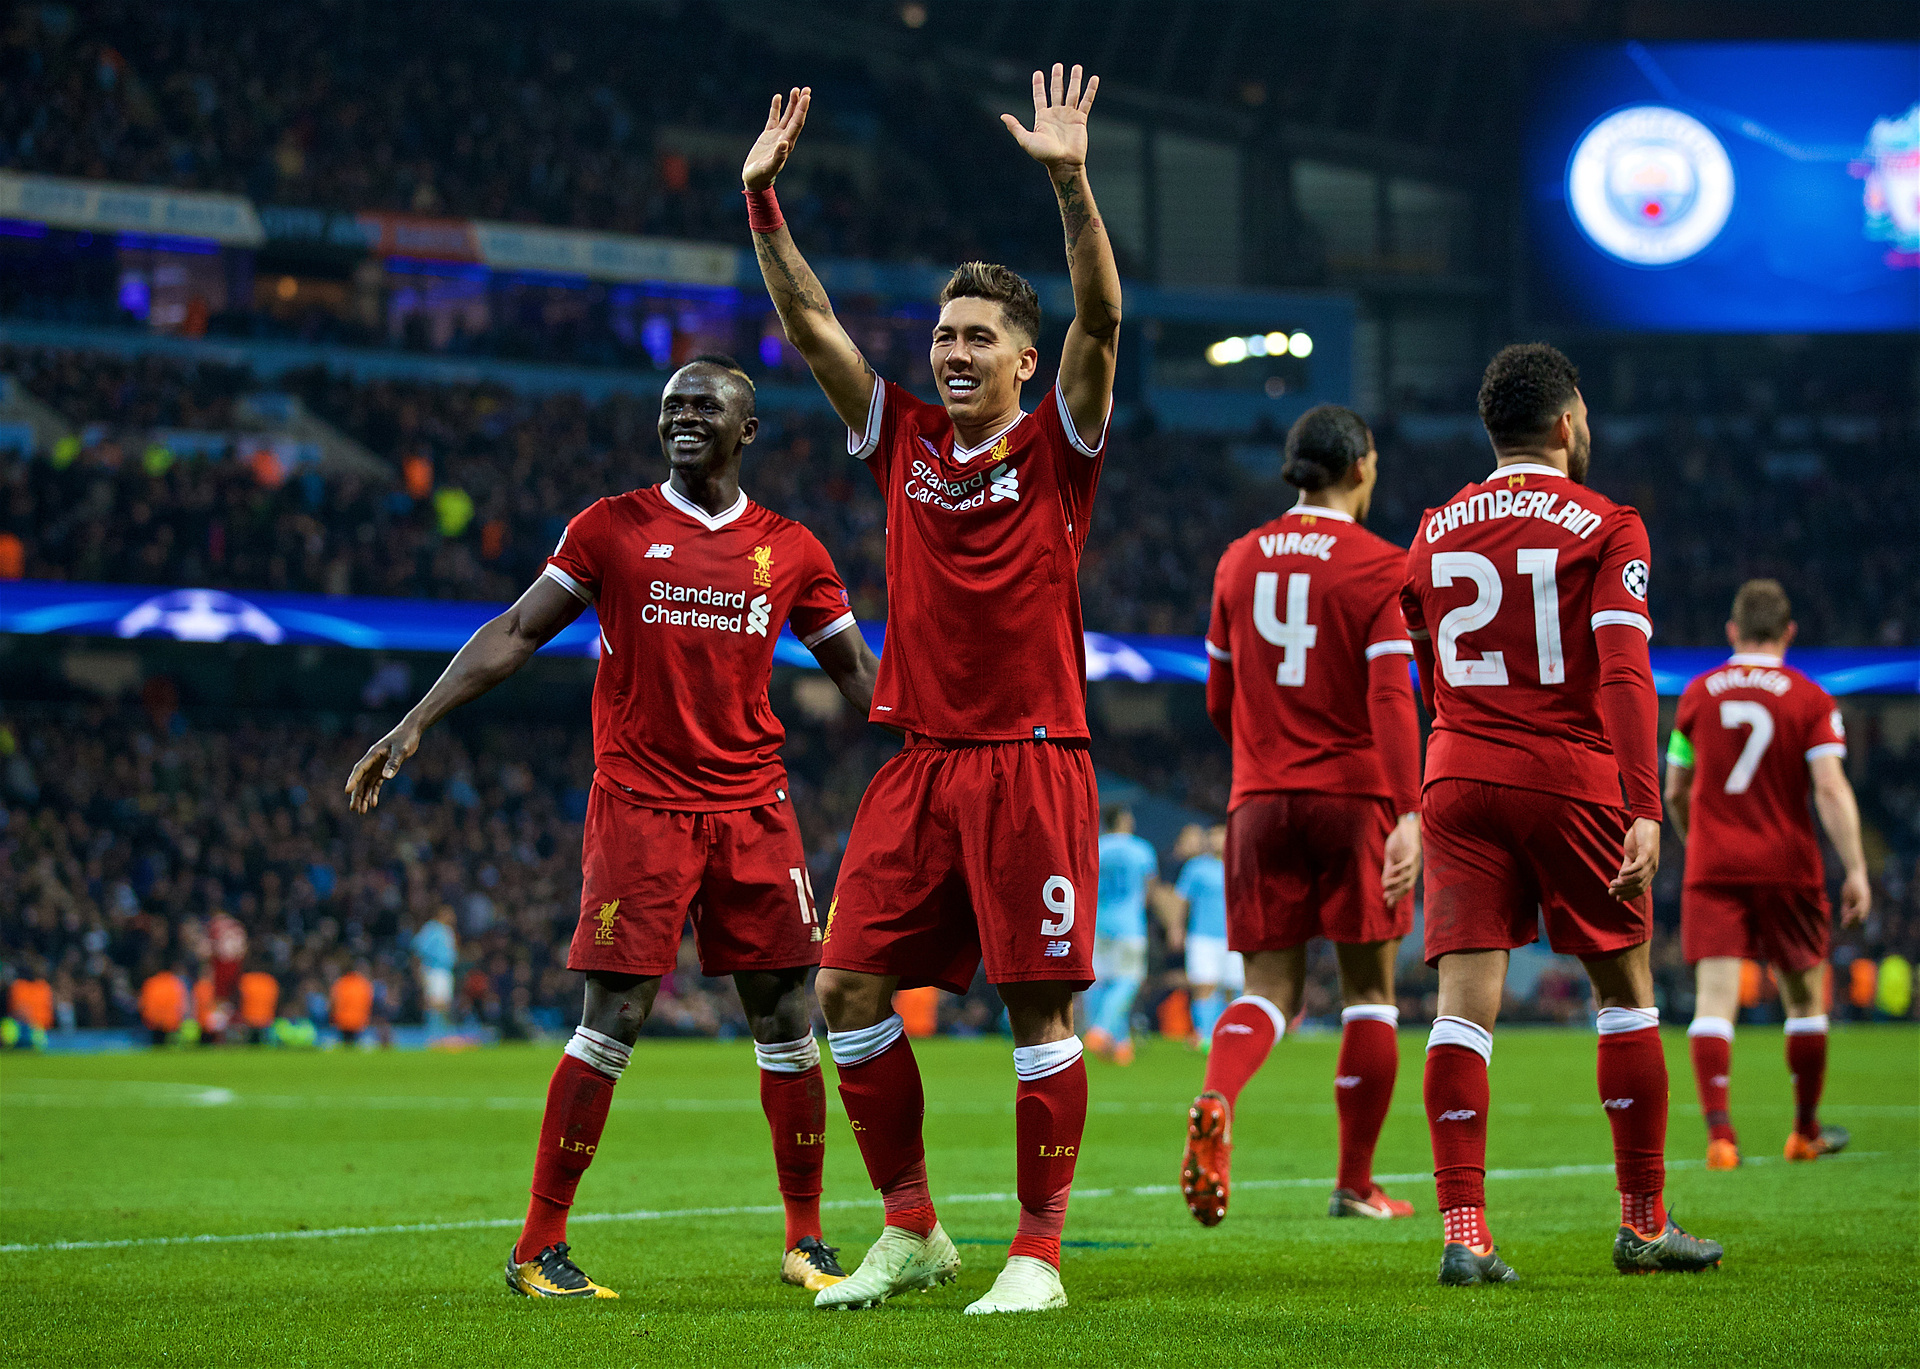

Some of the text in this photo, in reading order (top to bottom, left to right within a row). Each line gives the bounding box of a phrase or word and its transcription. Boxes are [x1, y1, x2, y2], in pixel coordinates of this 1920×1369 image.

[911, 460, 984, 498] Standard
[1425, 489, 1603, 545] CHAMBERLAIN
[1258, 532, 1338, 562] VIRGIL
[641, 603, 742, 634] Chartered
[649, 580, 746, 609] Standard
[1431, 547, 1565, 688] 21
[1252, 571, 1318, 687] 4
[1719, 699, 1776, 795] 7
[1040, 874, 1076, 937] 9
